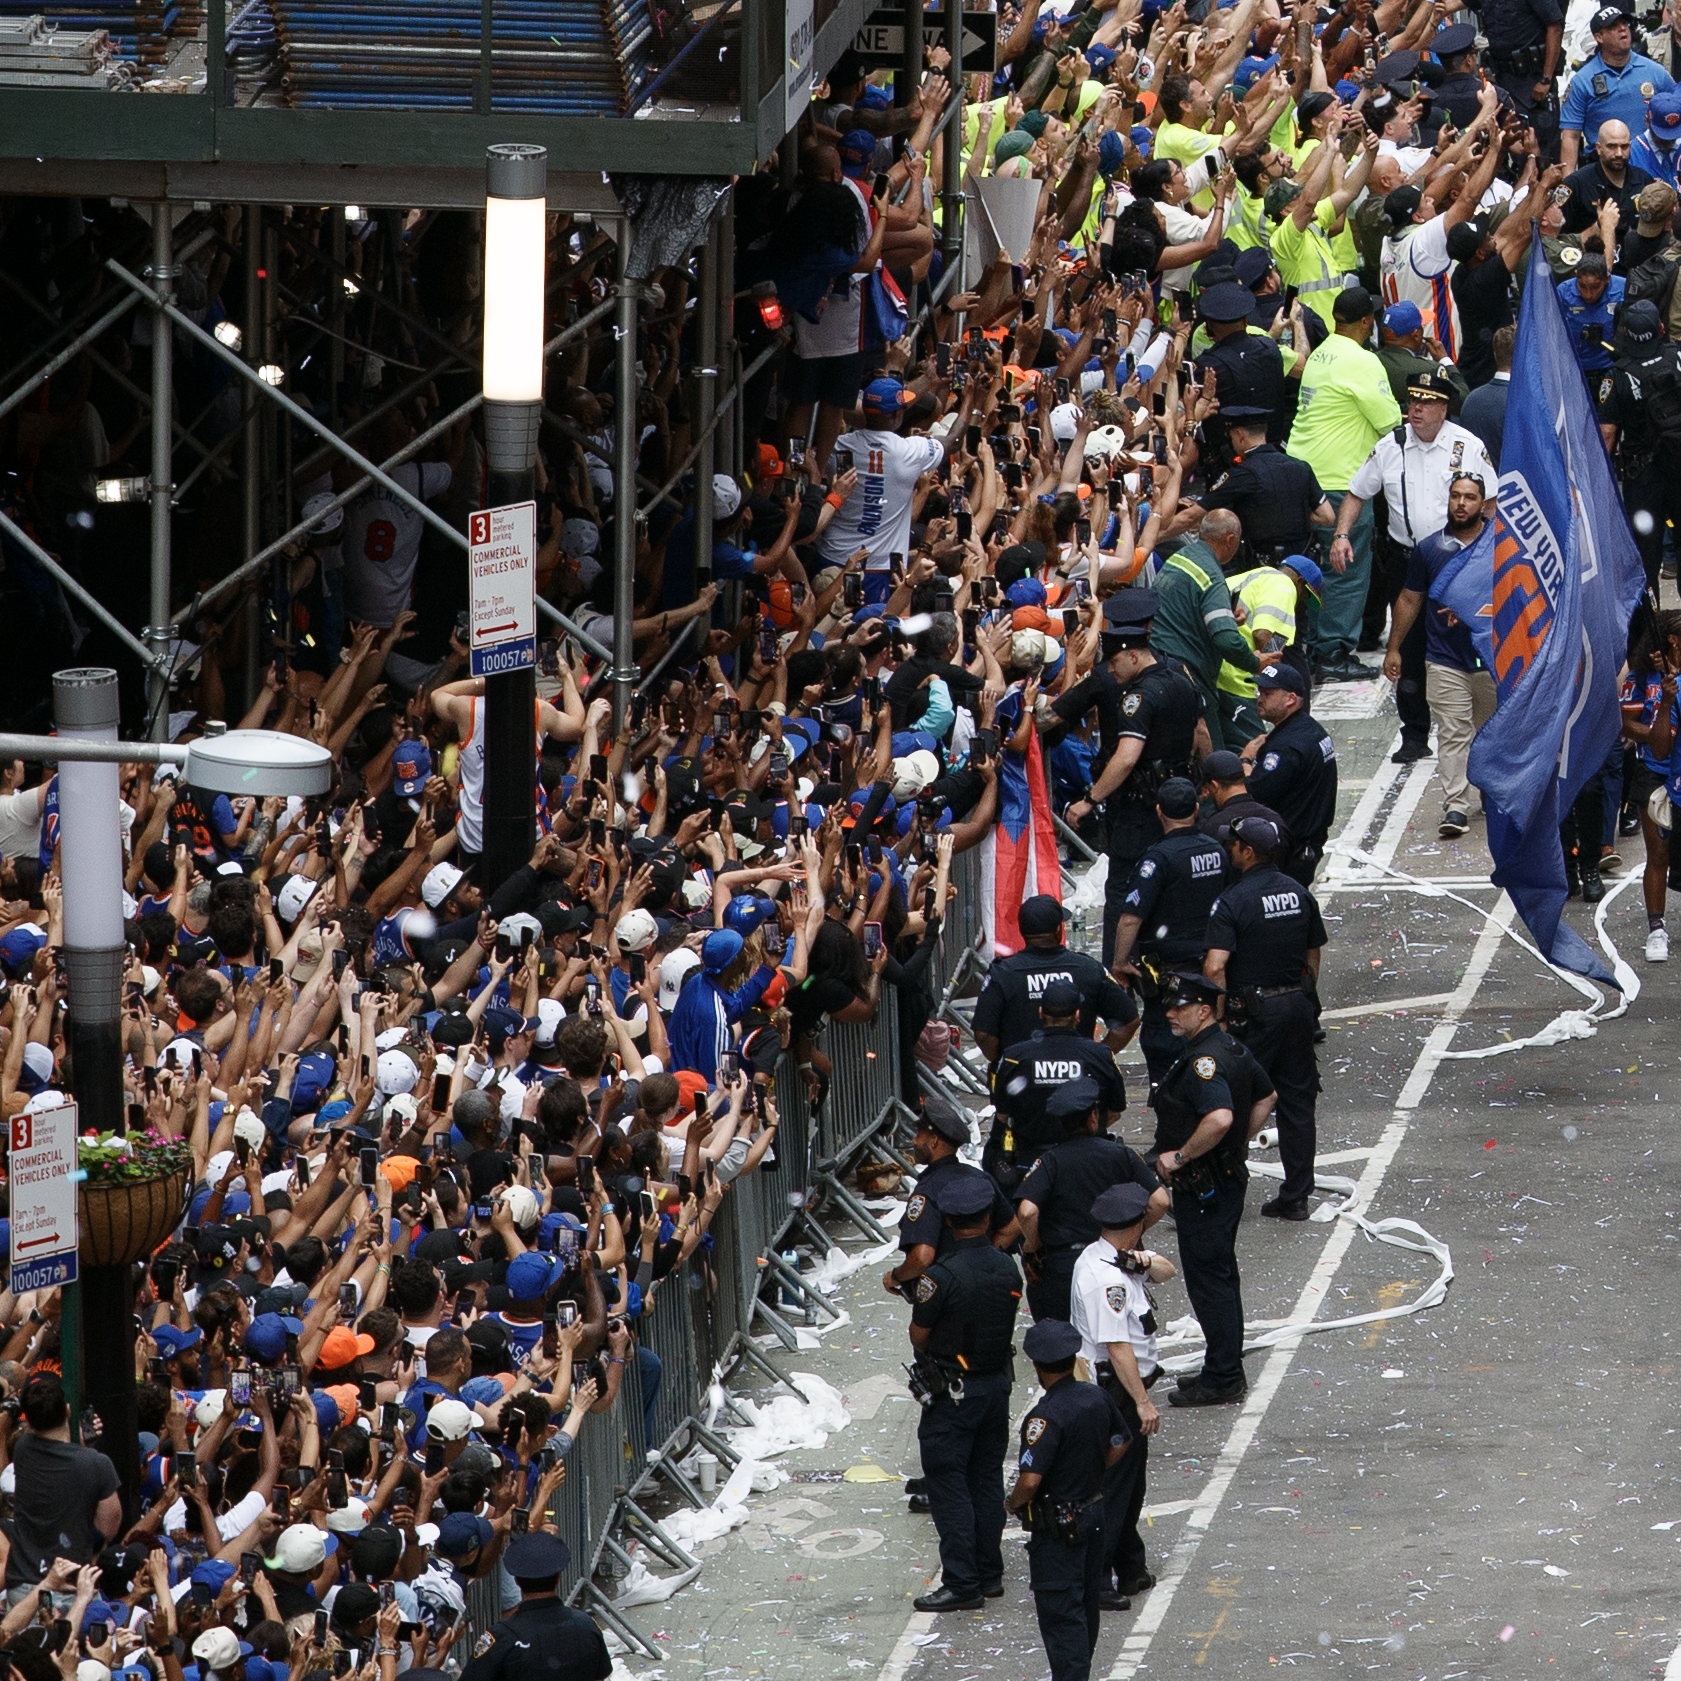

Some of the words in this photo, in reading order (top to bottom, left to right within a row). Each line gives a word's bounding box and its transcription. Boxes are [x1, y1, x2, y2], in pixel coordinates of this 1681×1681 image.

[868, 450, 884, 474] 11
[1497, 479, 1540, 545] NEW
[475, 517, 486, 542] 3
[363, 519, 397, 563] 8
[474, 544, 521, 564] COMMERCIAL
[474, 561, 509, 578] VEHICLES
[510, 557, 529, 571] ONLY
[474, 598, 486, 608] 7am
[492, 595, 504, 607] 7pm
[474, 609, 494, 623] Except
[495, 605, 515, 619] Sunday
[482, 651, 519, 672] 100057
[1190, 851, 1221, 873] NYPD
[1261, 892, 1300, 913] NYPD
[1034, 1060, 1082, 1079] NYPD
[15, 1119, 28, 1148] 3
[14, 1149, 64, 1171] COMMERCIAL
[14, 1167, 51, 1187] VEHICLES
[51, 1162, 71, 1178] ONLY
[15, 1221, 34, 1235] Except
[35, 1216, 57, 1231] Sunday
[12, 1266, 53, 1292] 100057
